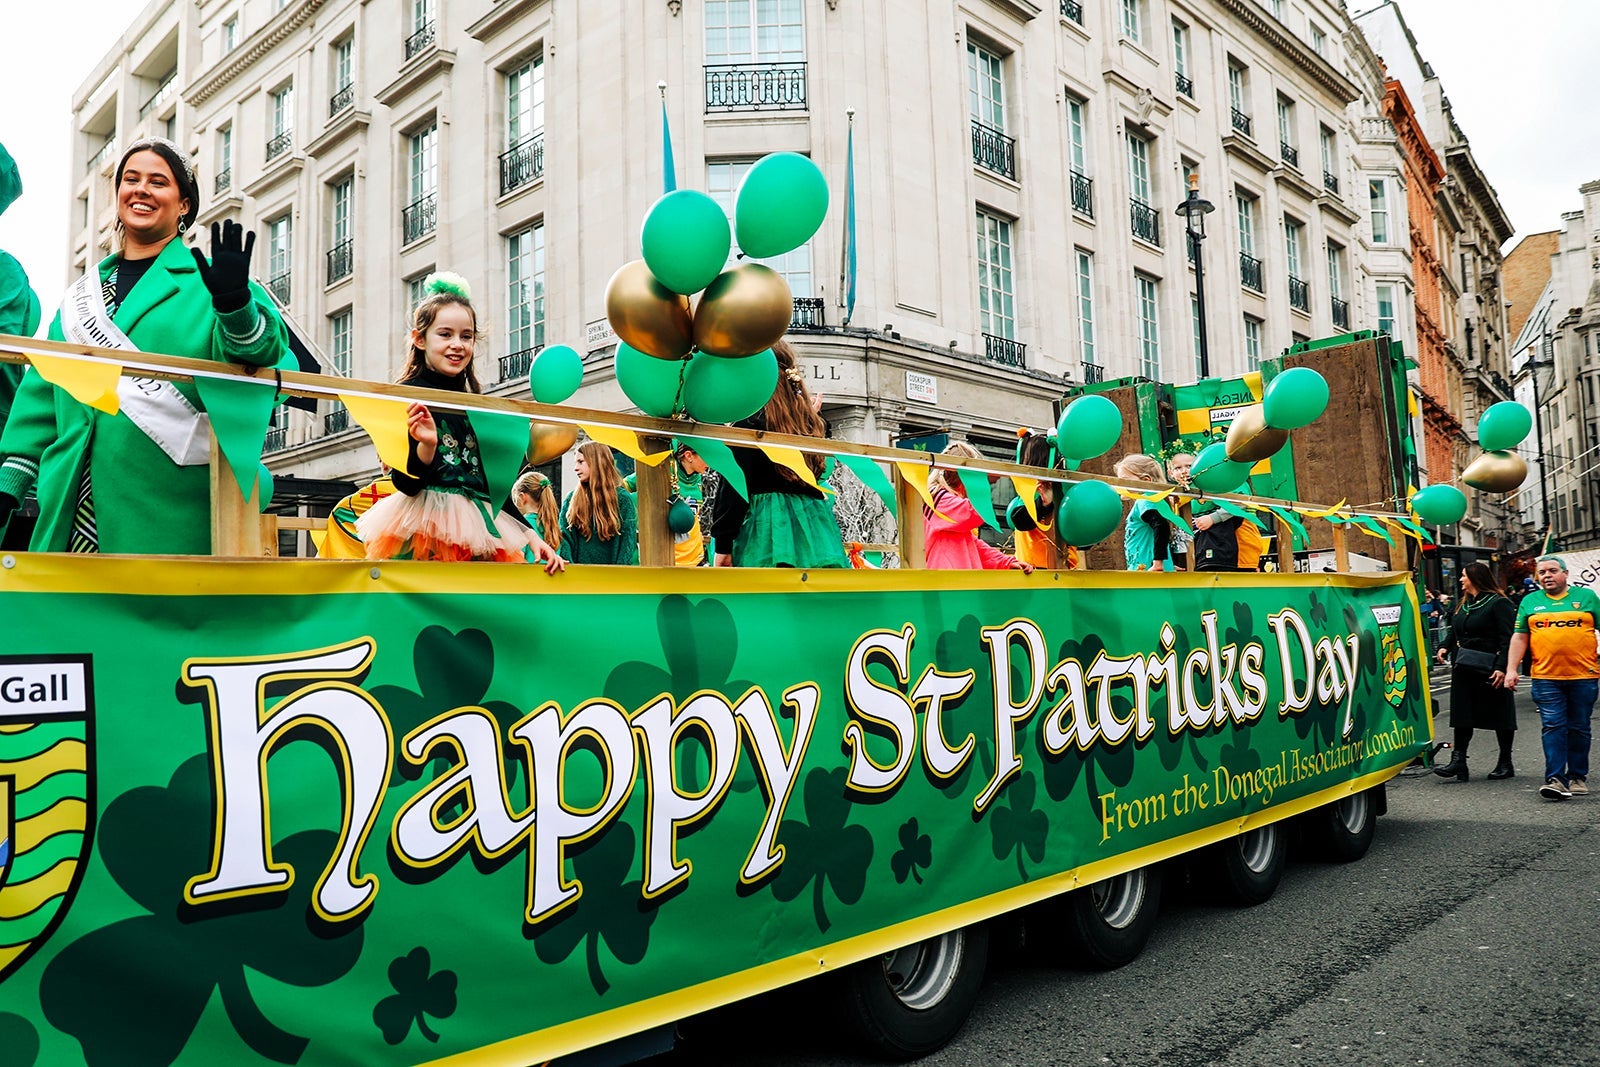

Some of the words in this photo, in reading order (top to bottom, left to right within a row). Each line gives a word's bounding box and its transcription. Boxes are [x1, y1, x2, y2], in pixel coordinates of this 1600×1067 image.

[588, 330, 608, 343] GARDENS
[797, 364, 841, 380] ELL
[909, 373, 931, 386] COCKSPUR
[909, 382, 925, 393] STREET
[925, 386, 935, 395] SW1
[1535, 618, 1583, 628] circet
[0, 673, 69, 704] Gall
[180, 635, 822, 926] Happy
[843, 621, 976, 793] St
[974, 610, 1268, 811] Patricks
[1267, 607, 1361, 739] Day
[1098, 788, 1166, 846] From
[1171, 773, 1209, 818] the
[1211, 758, 1287, 806] Donegal
[1289, 739, 1364, 785] Association
[1365, 720, 1416, 760] London
